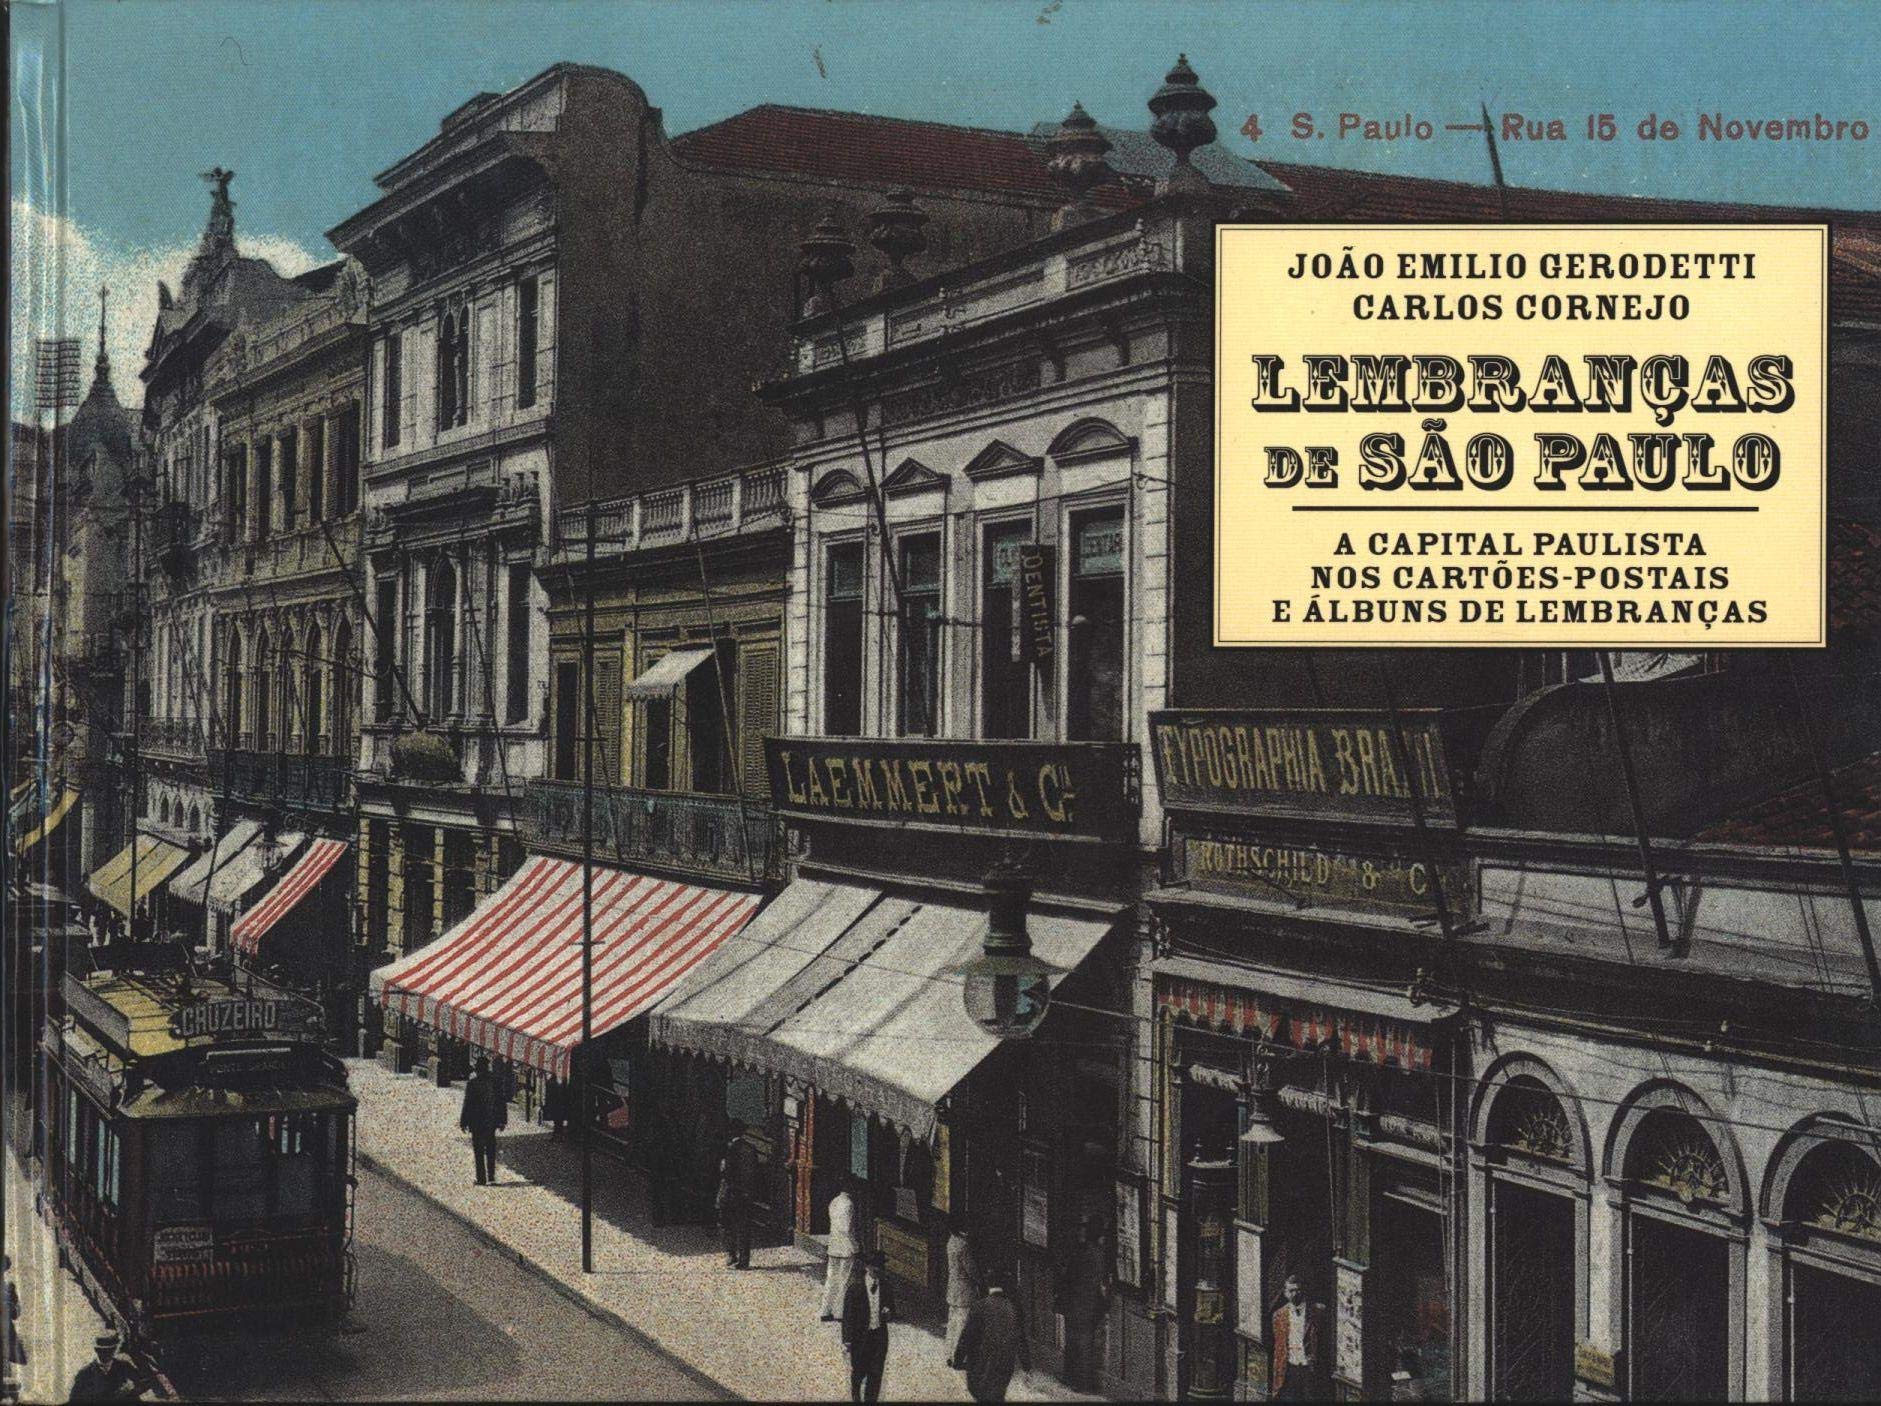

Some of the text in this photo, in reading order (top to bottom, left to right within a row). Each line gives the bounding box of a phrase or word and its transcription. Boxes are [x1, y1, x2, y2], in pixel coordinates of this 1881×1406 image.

[1239, 112, 1263, 143] 4
[1291, 112, 1325, 141] S.
[1339, 112, 1434, 142] Paulo
[1502, 113, 1567, 142] Rua
[1588, 113, 1617, 142] 15
[1638, 113, 1681, 142] de
[1700, 113, 1870, 142] Novembro
[1288, 246, 1757, 280] JOÃO EMILIO GERODETTI
[1353, 294, 1691, 322] CARLOS CORNEJO
[1252, 354, 1797, 427] LEMBRANÇAS
[1264, 418, 1782, 492] DE SÃO PAULO
[1334, 532, 1708, 557] A CAPITAL PAULISTA
[1311, 560, 1731, 591] NOS CARTÕES-POSTAIS
[1022, 552, 1054, 658] DENTISTA
[1272, 594, 1769, 630] E ÁLBUNS DE LEMBRANÇAS
[1157, 725, 1327, 793] TYPOGRAPHIA
[780, 752, 993, 818] LAEMMERT
[1007, 770, 1029, 819] &
[181, 1001, 277, 1036] CRUZEIRO
